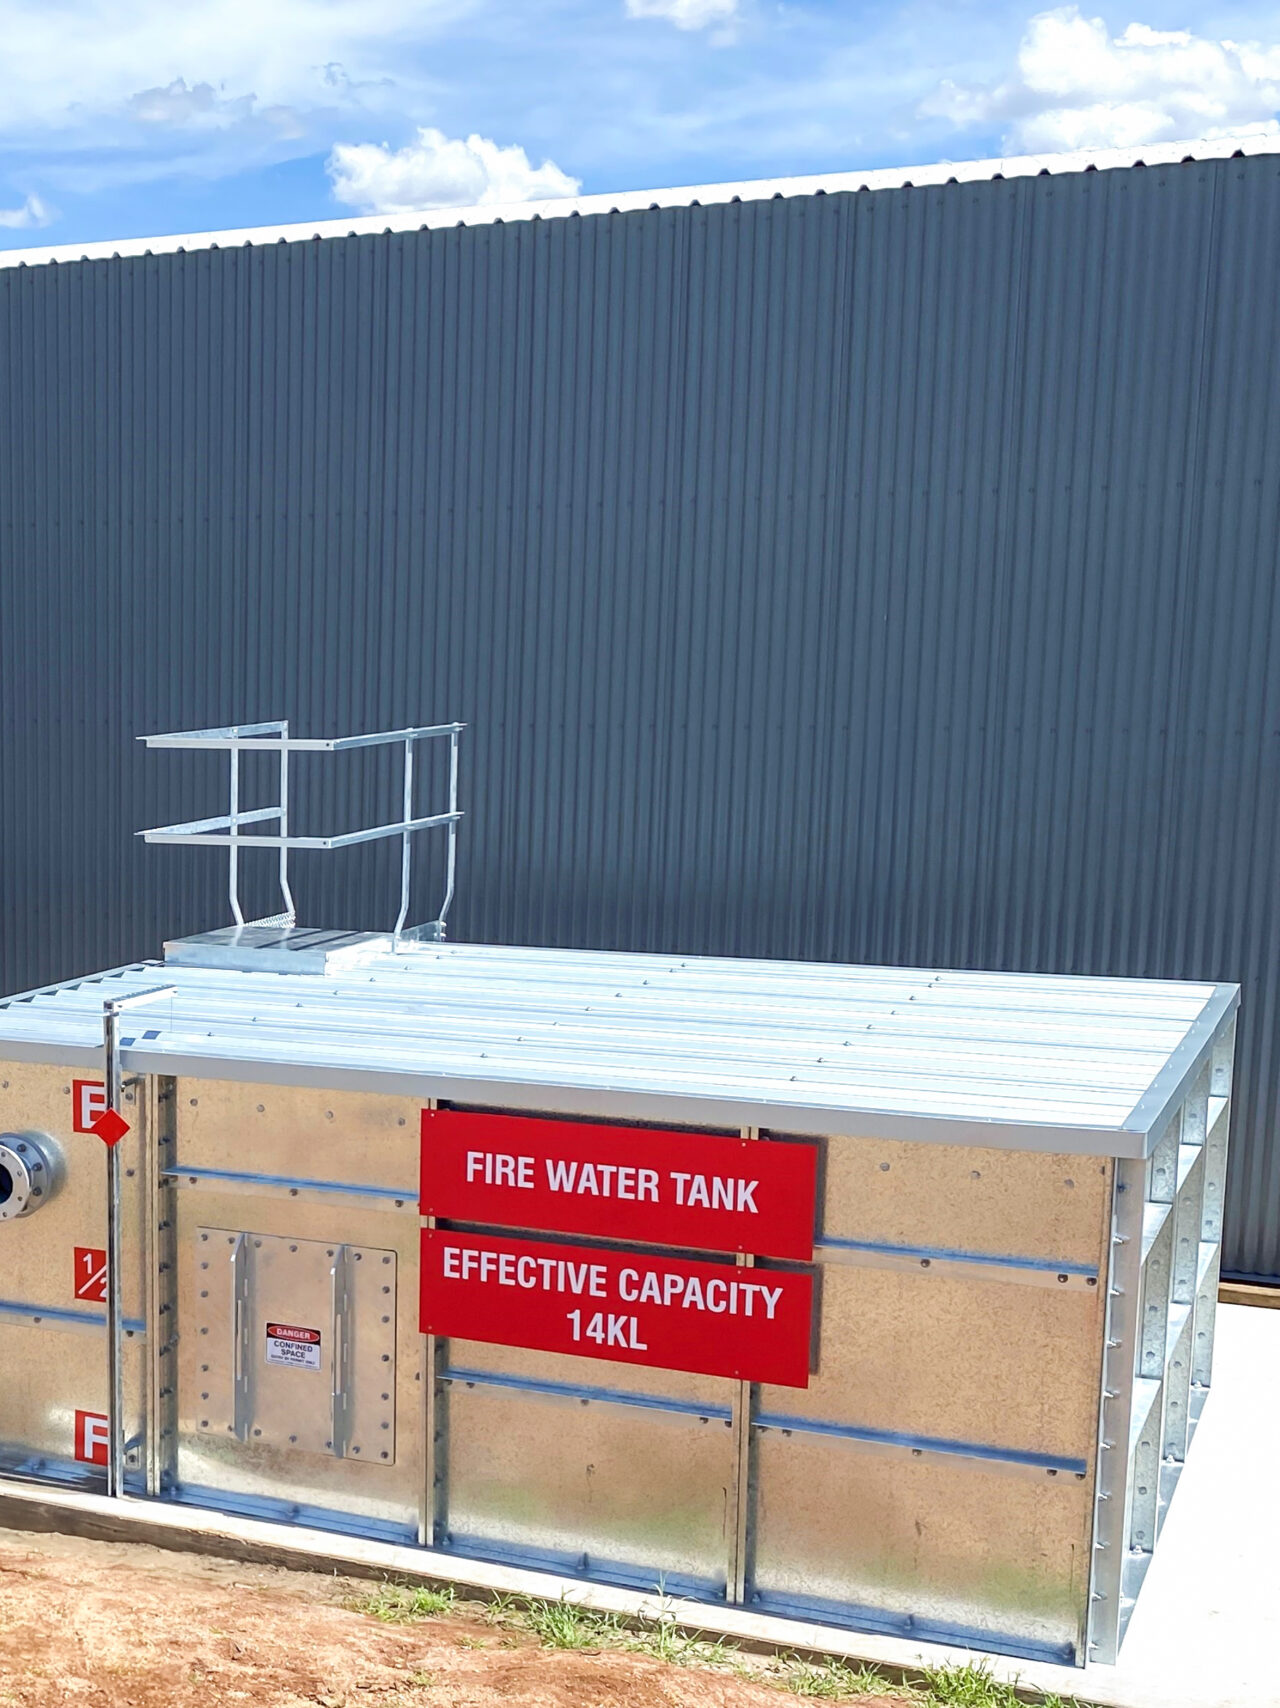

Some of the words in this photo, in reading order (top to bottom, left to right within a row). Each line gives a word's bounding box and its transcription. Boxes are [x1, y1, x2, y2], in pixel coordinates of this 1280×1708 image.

[81, 1084, 106, 1128] E
[466, 1150, 535, 1190] FIRE
[545, 1158, 660, 1203] WATER
[669, 1171, 759, 1214] TANK
[442, 1246, 608, 1298] EFFECTIVE
[618, 1267, 784, 1320] CAPACITY
[273, 1340, 313, 1352] CONFINED
[276, 1328, 311, 1340] DANGER
[566, 1309, 648, 1351] 14KL
[281, 1349, 306, 1359] SPACE
[84, 1415, 109, 1459] F
